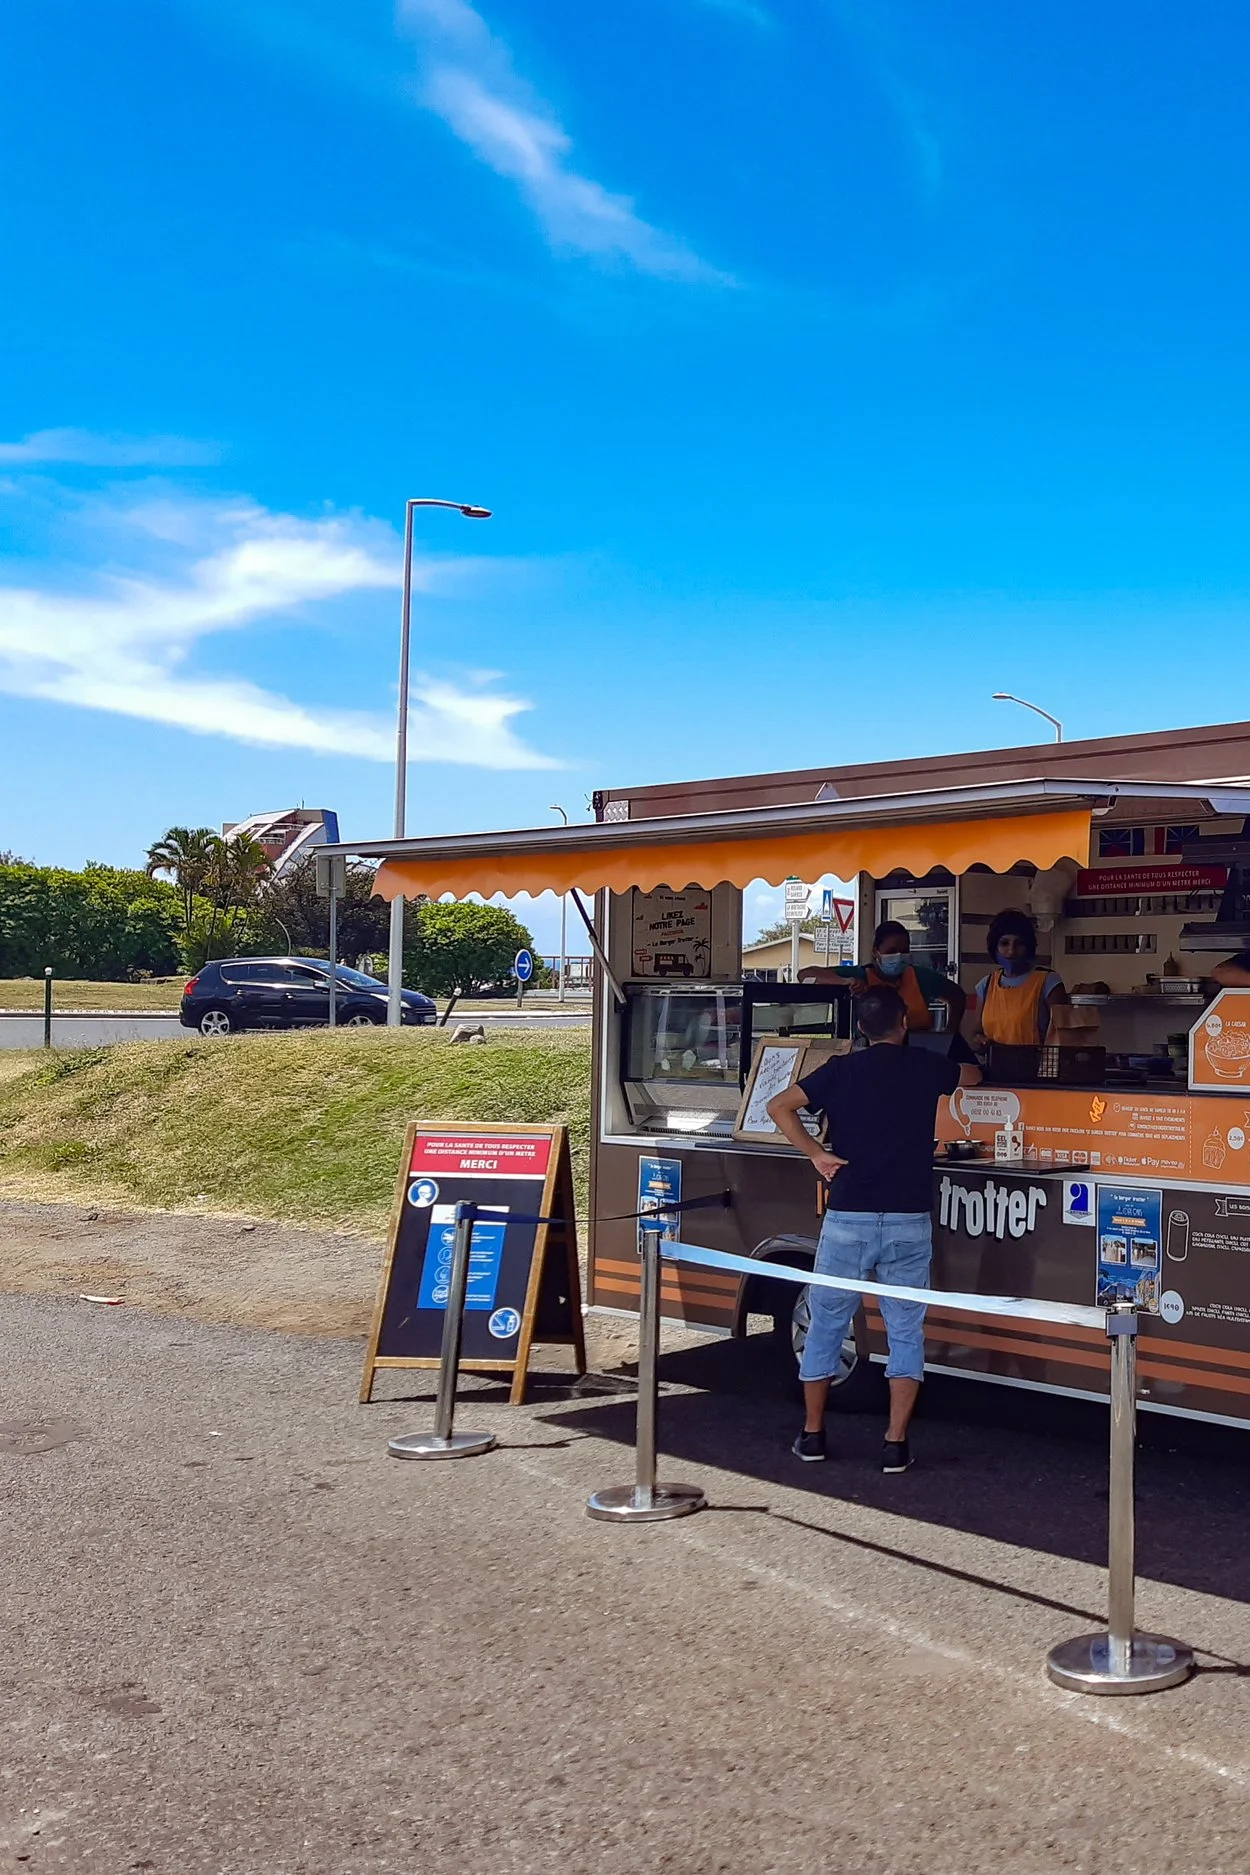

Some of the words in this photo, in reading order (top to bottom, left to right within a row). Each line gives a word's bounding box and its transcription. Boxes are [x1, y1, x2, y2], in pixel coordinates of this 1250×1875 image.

[1100, 882, 1127, 890] DISTANCE
[1128, 881, 1156, 889] MINIMUM
[649, 921, 672, 931] NOTRE
[676, 917, 695, 927] PAGE
[459, 1159, 498, 1170] MERCI
[1147, 1157, 1161, 1168] Pay
[940, 1176, 1047, 1240] trotter
